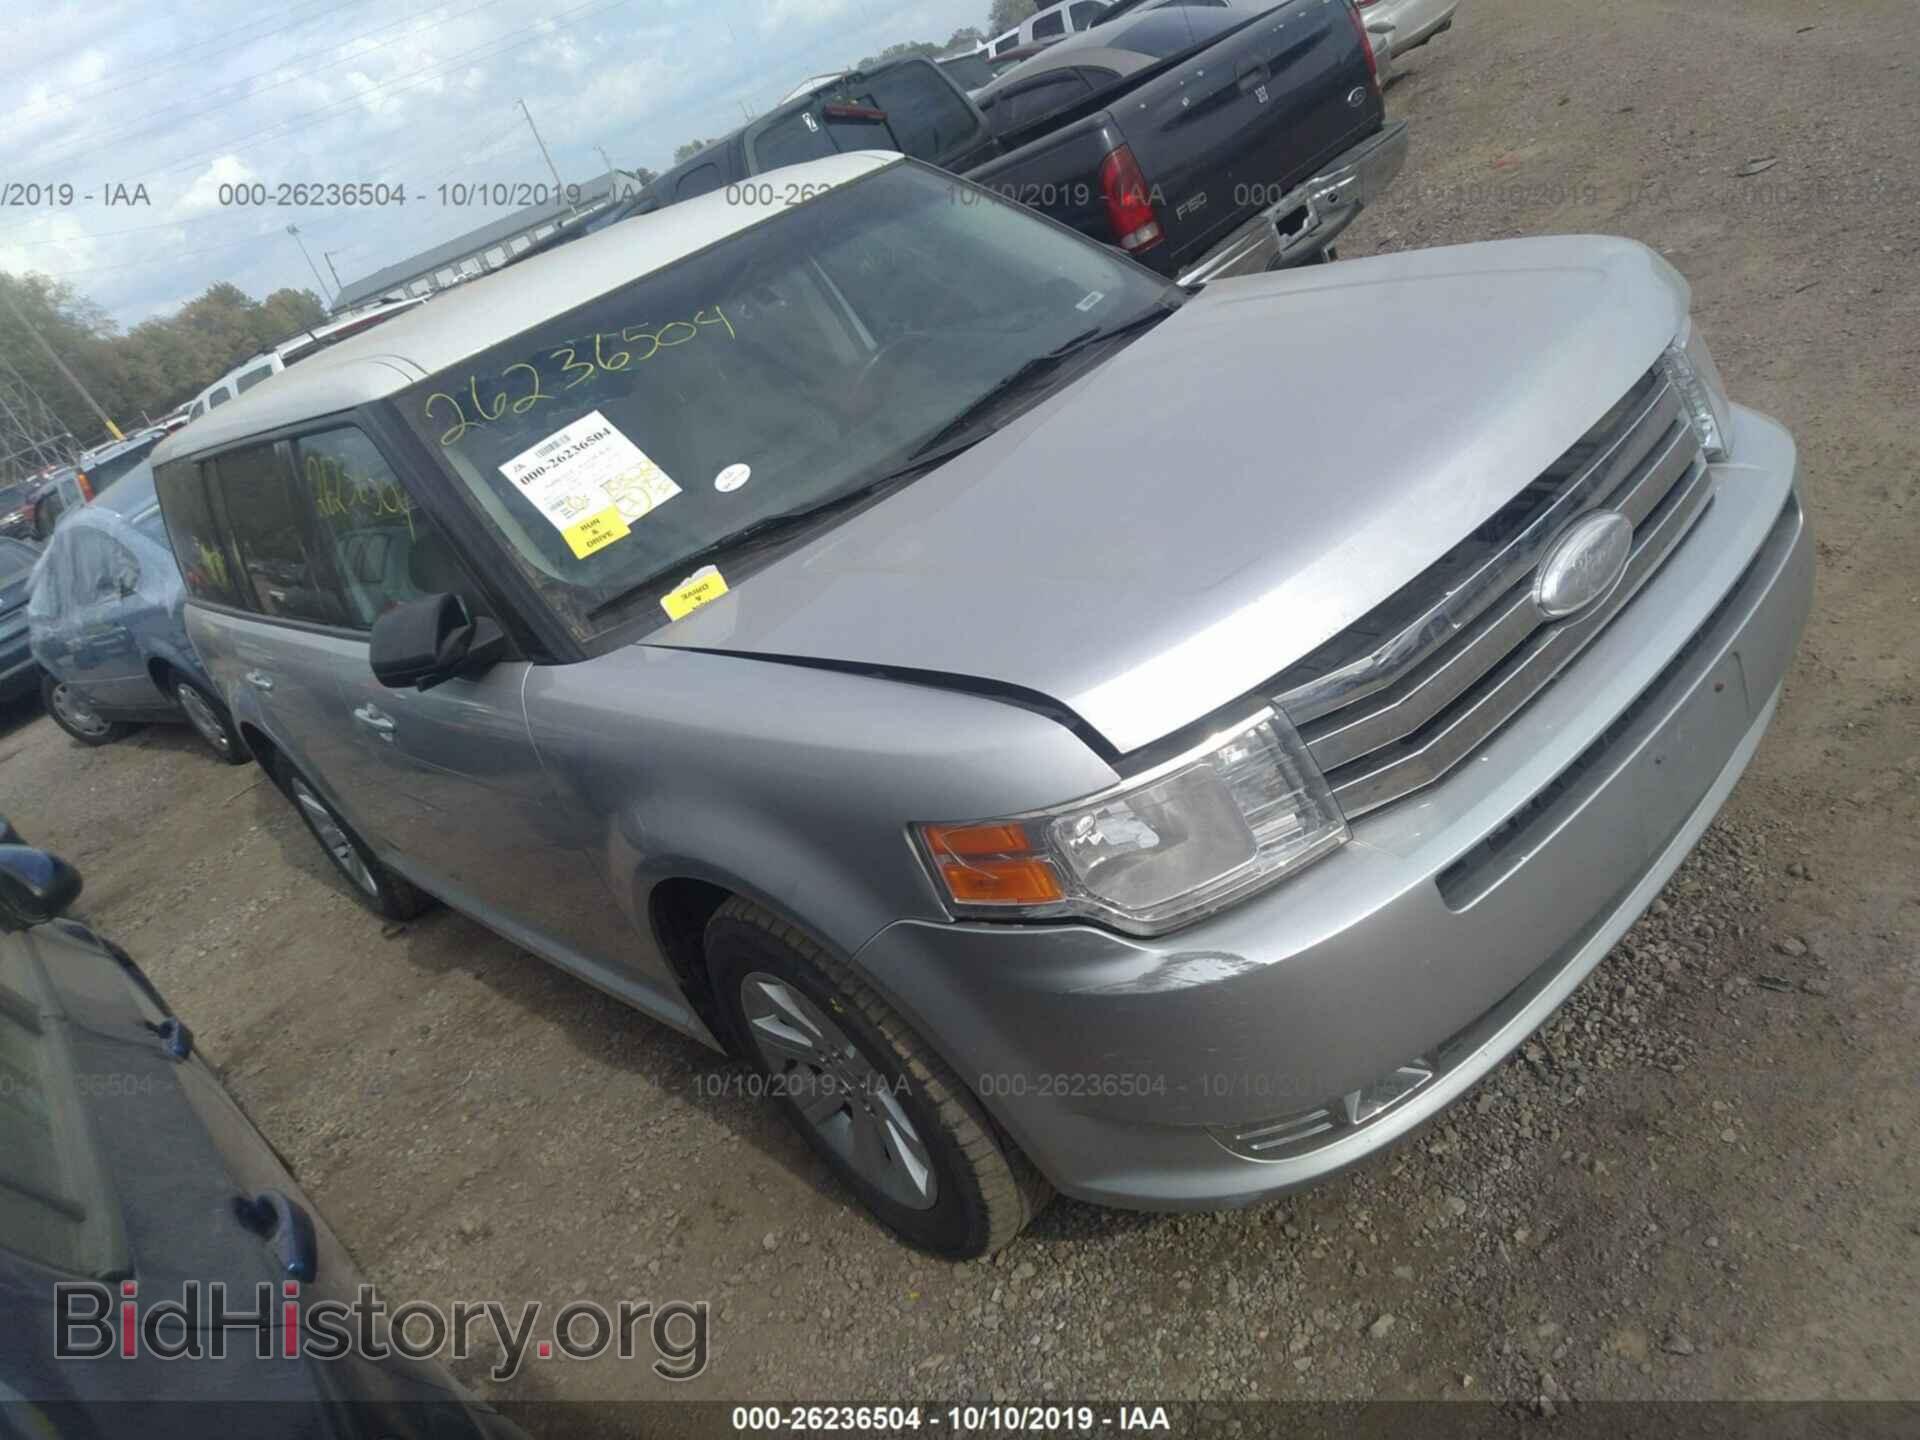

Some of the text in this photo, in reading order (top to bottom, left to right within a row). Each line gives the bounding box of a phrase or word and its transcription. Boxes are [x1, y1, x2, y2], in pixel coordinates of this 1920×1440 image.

[1175, 191, 1208, 221] F150
[425, 304, 736, 446] 26236504
[519, 426, 612, 486] 000-26236504
